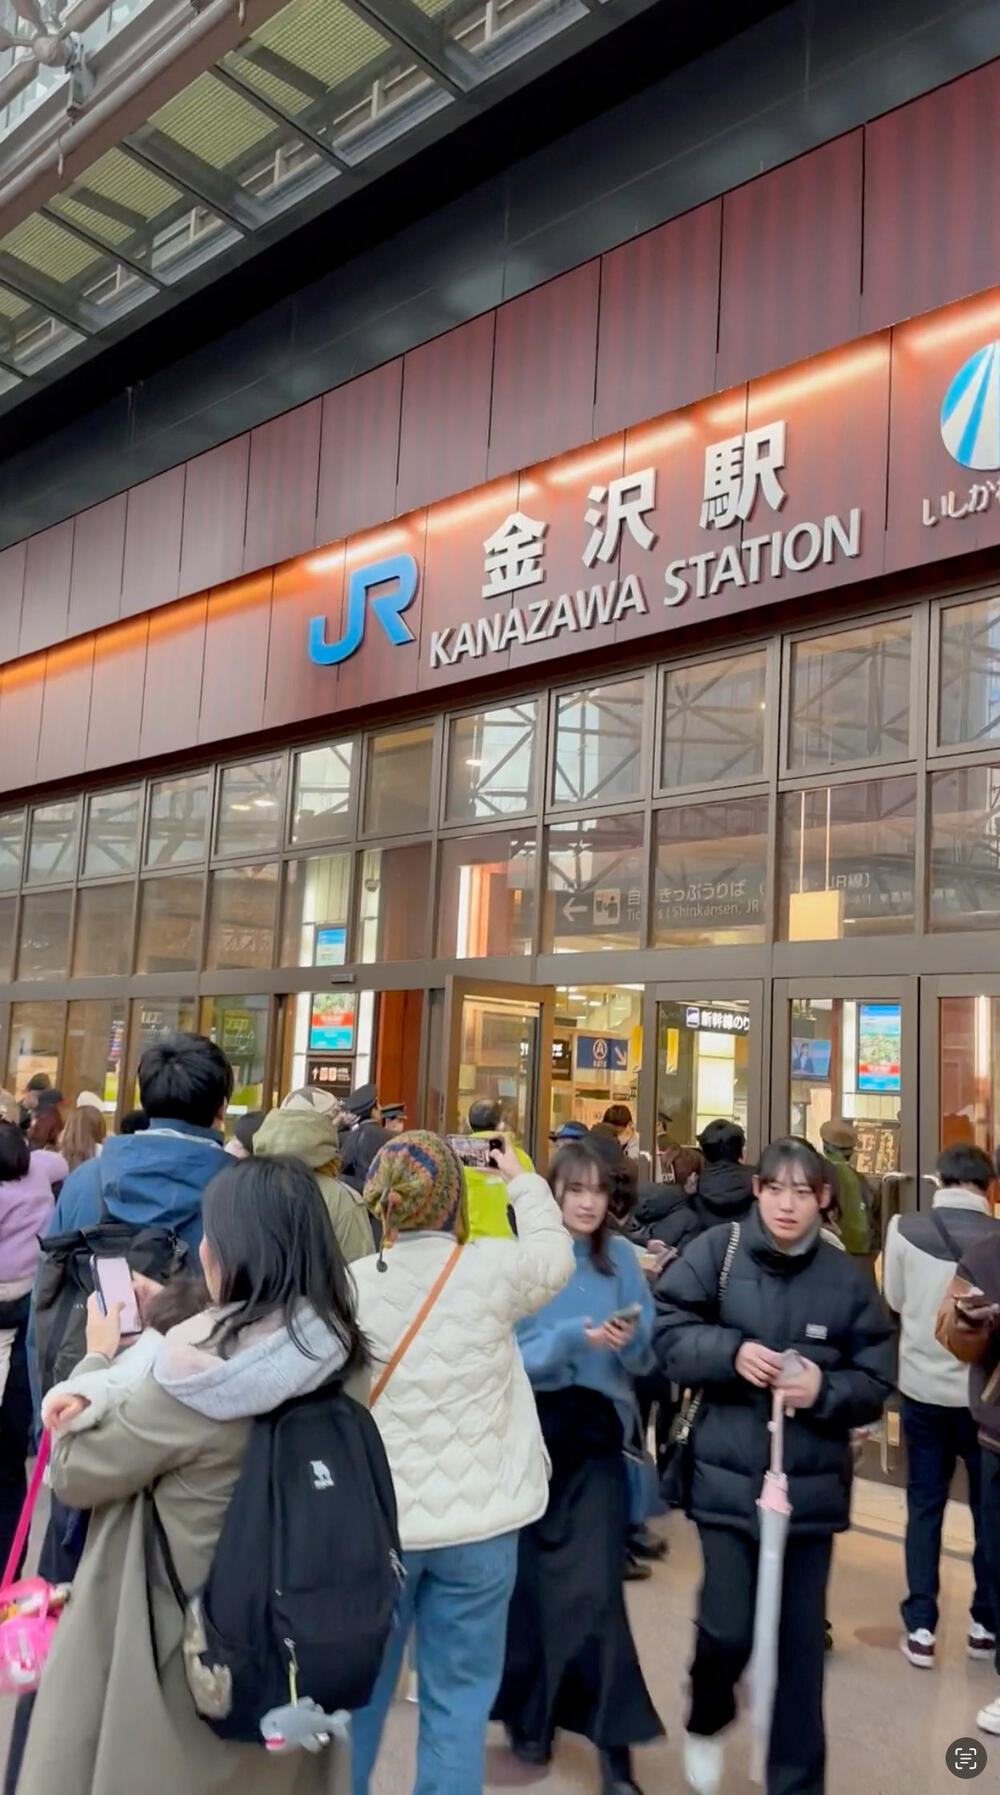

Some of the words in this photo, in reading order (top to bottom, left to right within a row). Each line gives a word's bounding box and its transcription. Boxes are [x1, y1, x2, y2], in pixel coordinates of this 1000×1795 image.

[481, 420, 788, 598] 金沢駅
[922, 479, 1000, 526] いしか
[308, 552, 418, 666] JR
[429, 573, 648, 668] KANAZAWA
[664, 508, 862, 607] STATION
